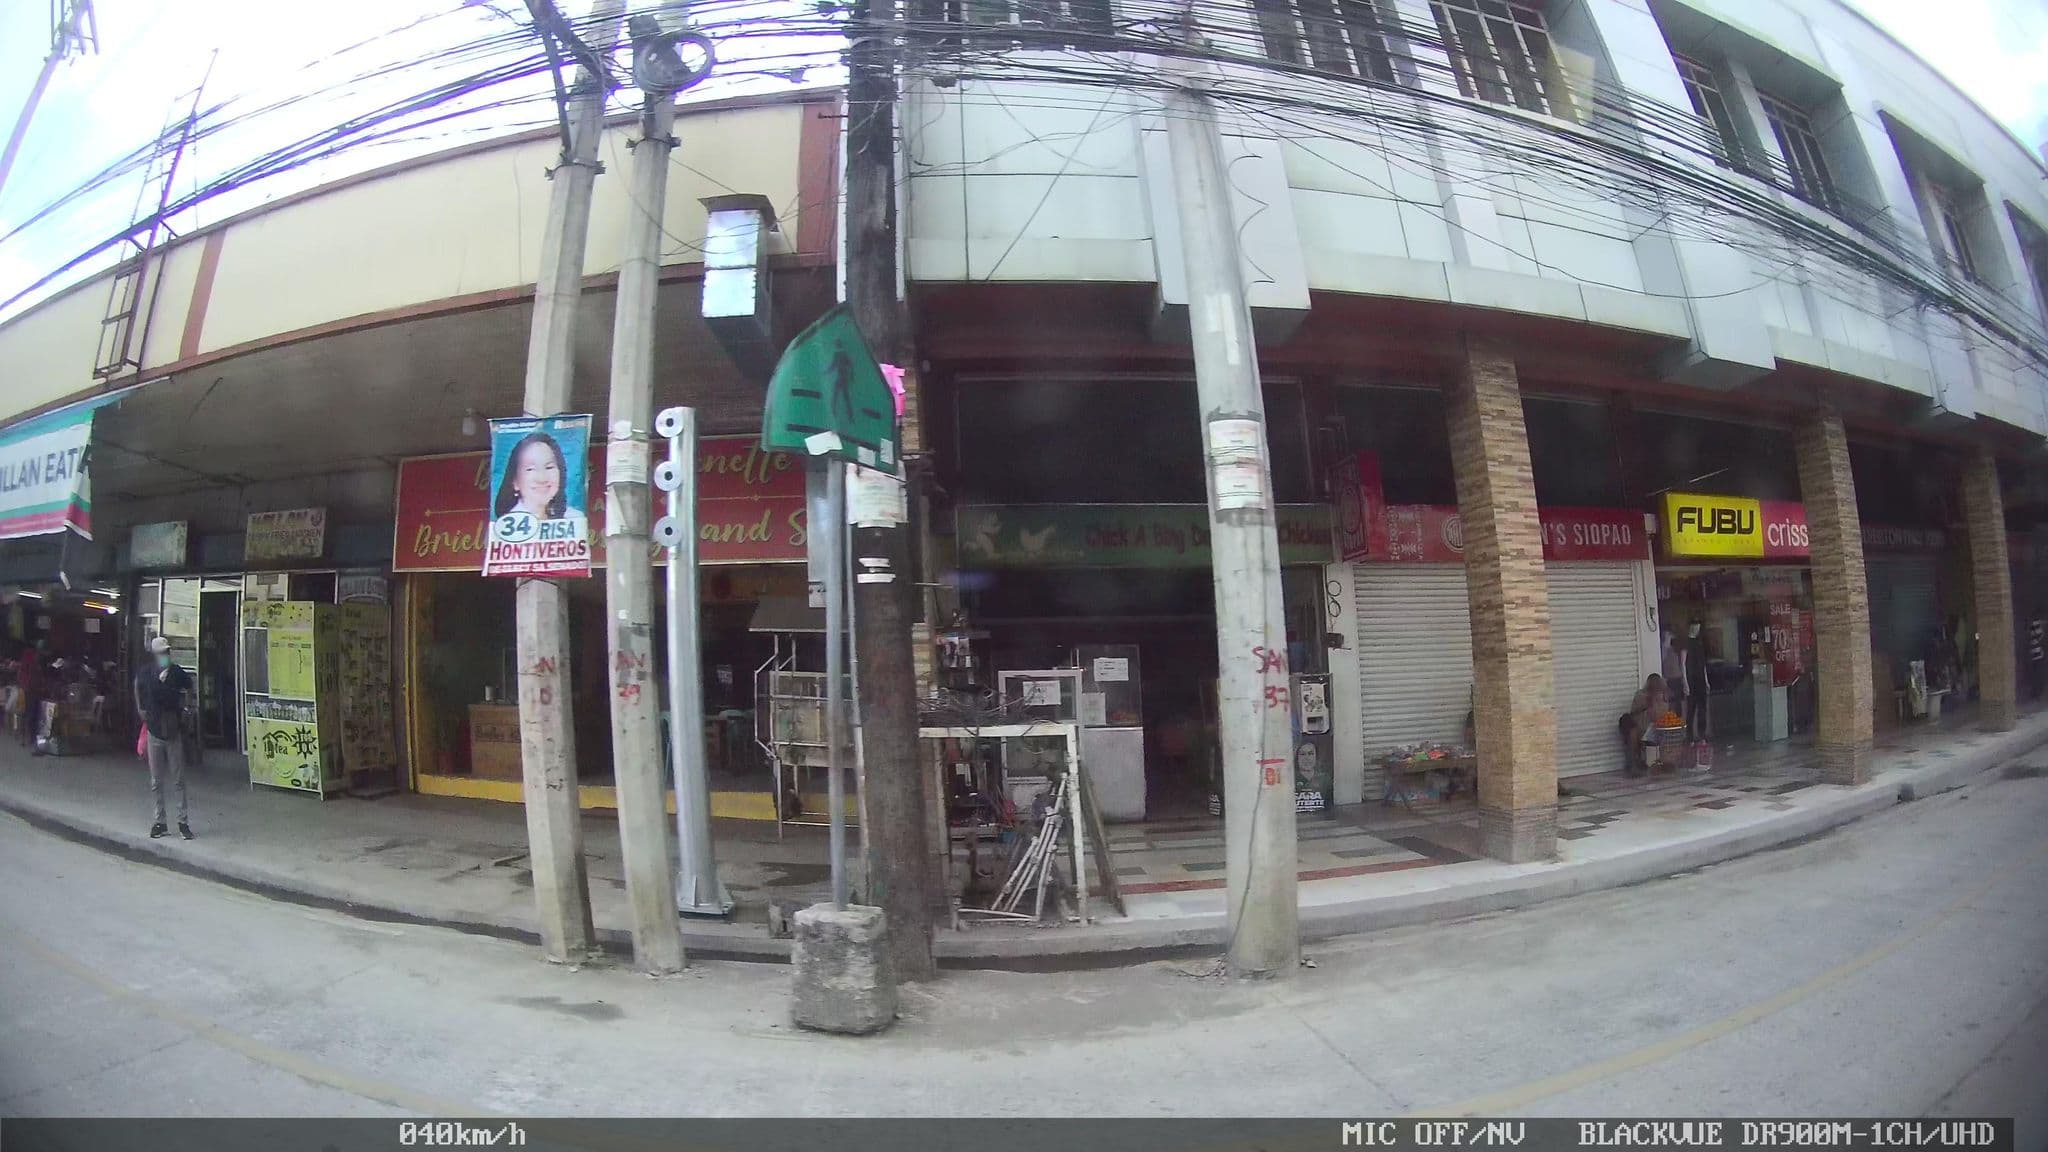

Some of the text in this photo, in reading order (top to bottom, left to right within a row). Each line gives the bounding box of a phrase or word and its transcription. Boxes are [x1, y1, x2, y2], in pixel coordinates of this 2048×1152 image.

[46, 446, 82, 484] EAT
[499, 516, 530, 537] 34
[538, 520, 574, 540] RISA
[700, 508, 772, 543] and
[1677, 506, 1754, 535] FUBU
[1572, 522, 1631, 546] SIOPAO
[490, 540, 586, 561] HONTIVEROS
[1769, 603, 1791, 616] SALE
